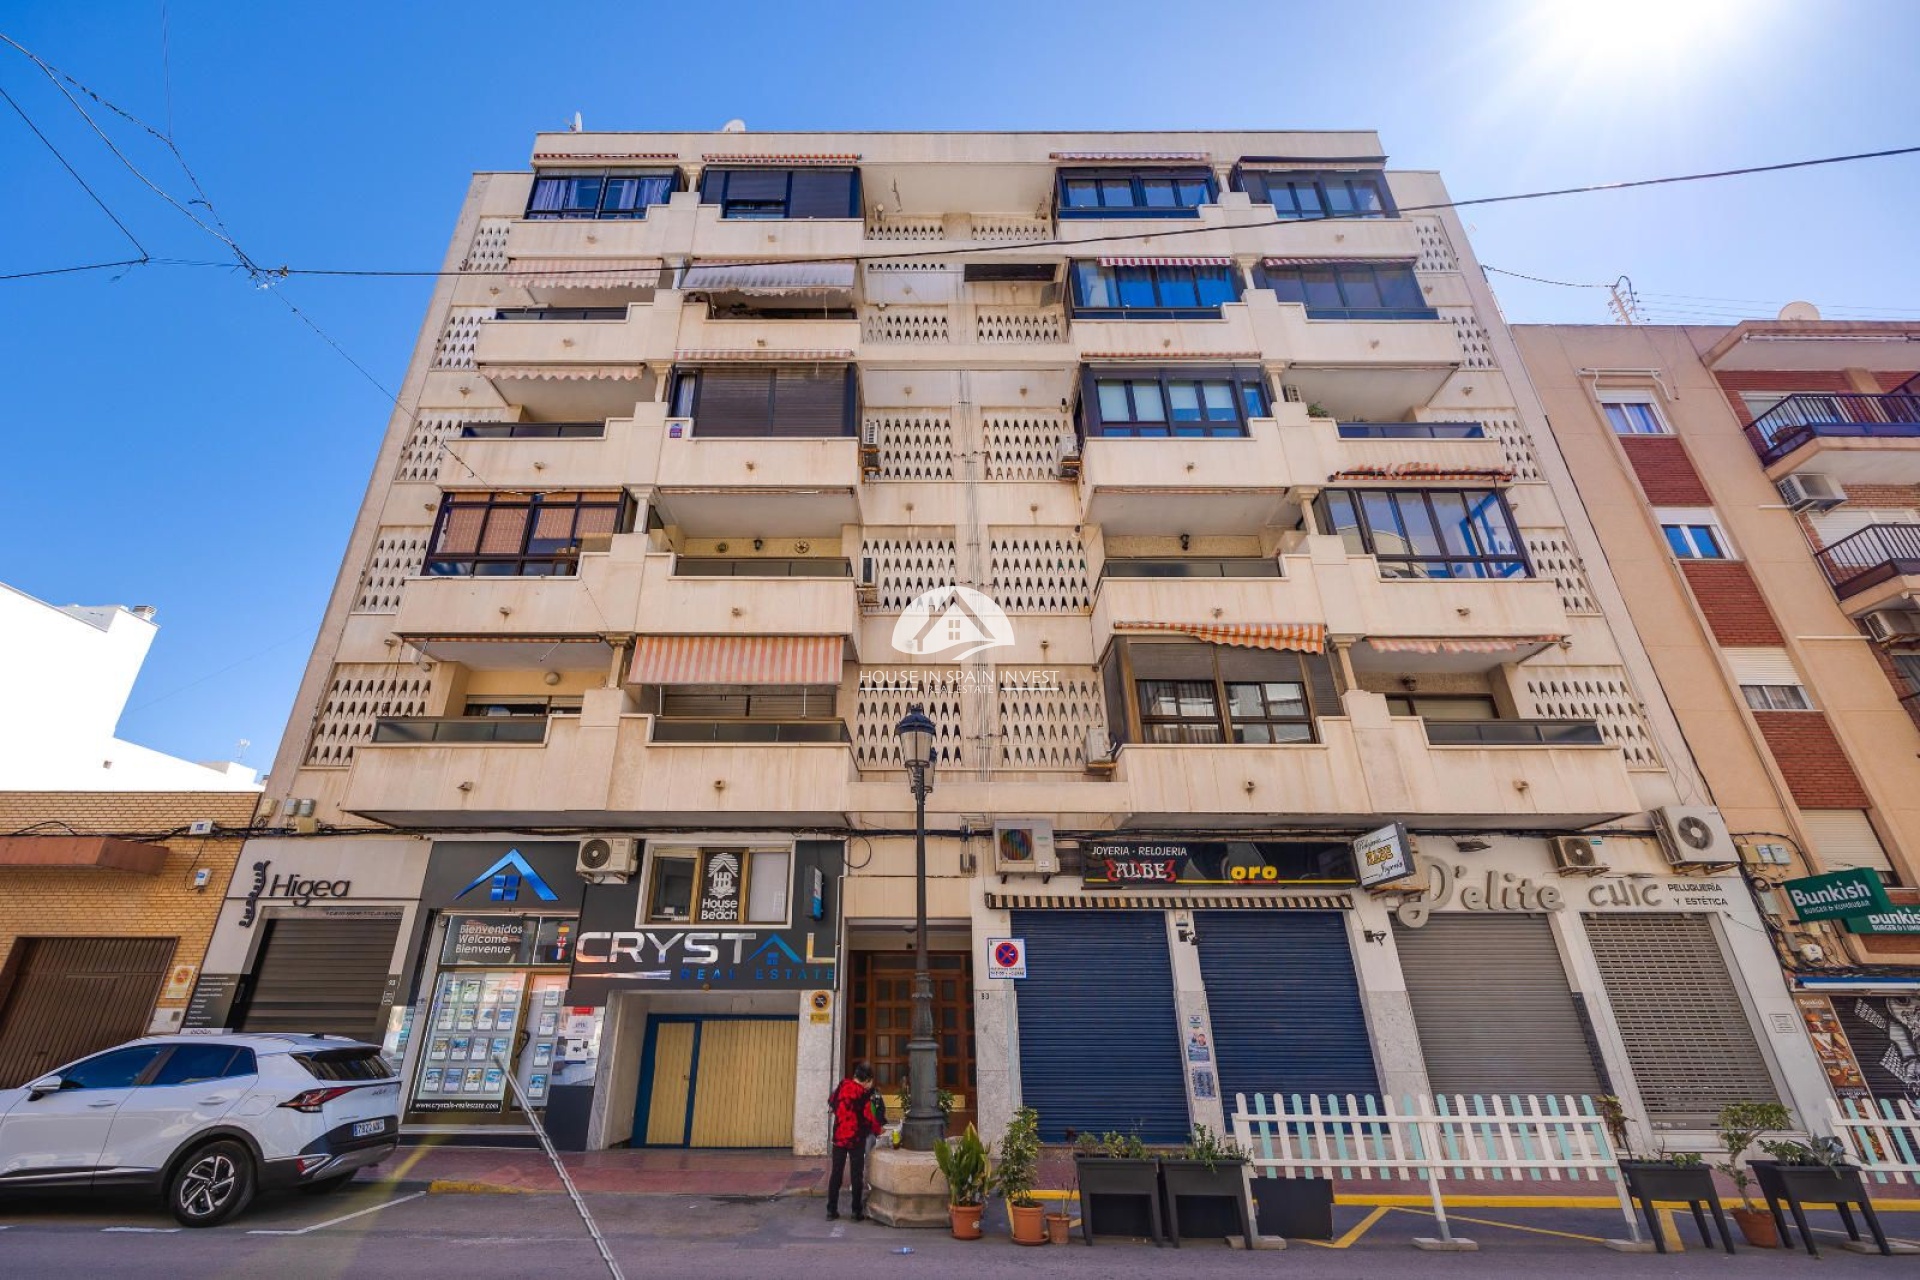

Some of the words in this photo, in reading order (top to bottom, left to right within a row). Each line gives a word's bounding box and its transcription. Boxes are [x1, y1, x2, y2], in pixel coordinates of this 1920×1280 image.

[1092, 846, 1130, 855] JOYERIA
[1138, 846, 1188, 856] RELOJERIA
[1115, 863, 1167, 879] ALBE
[1230, 865, 1278, 880] oro
[269, 873, 351, 907] Higea
[1790, 880, 1872, 907] Bunkish
[702, 898, 738, 908] House
[1673, 897, 1680, 906] Y
[701, 909, 738, 920] Beach
[460, 924, 523, 934] Bienvenidos
[458, 934, 509, 944] Welcome
[455, 944, 511, 954] Bienvenue
[680, 968, 734, 980] REAL
[755, 968, 835, 980] ESTATE
